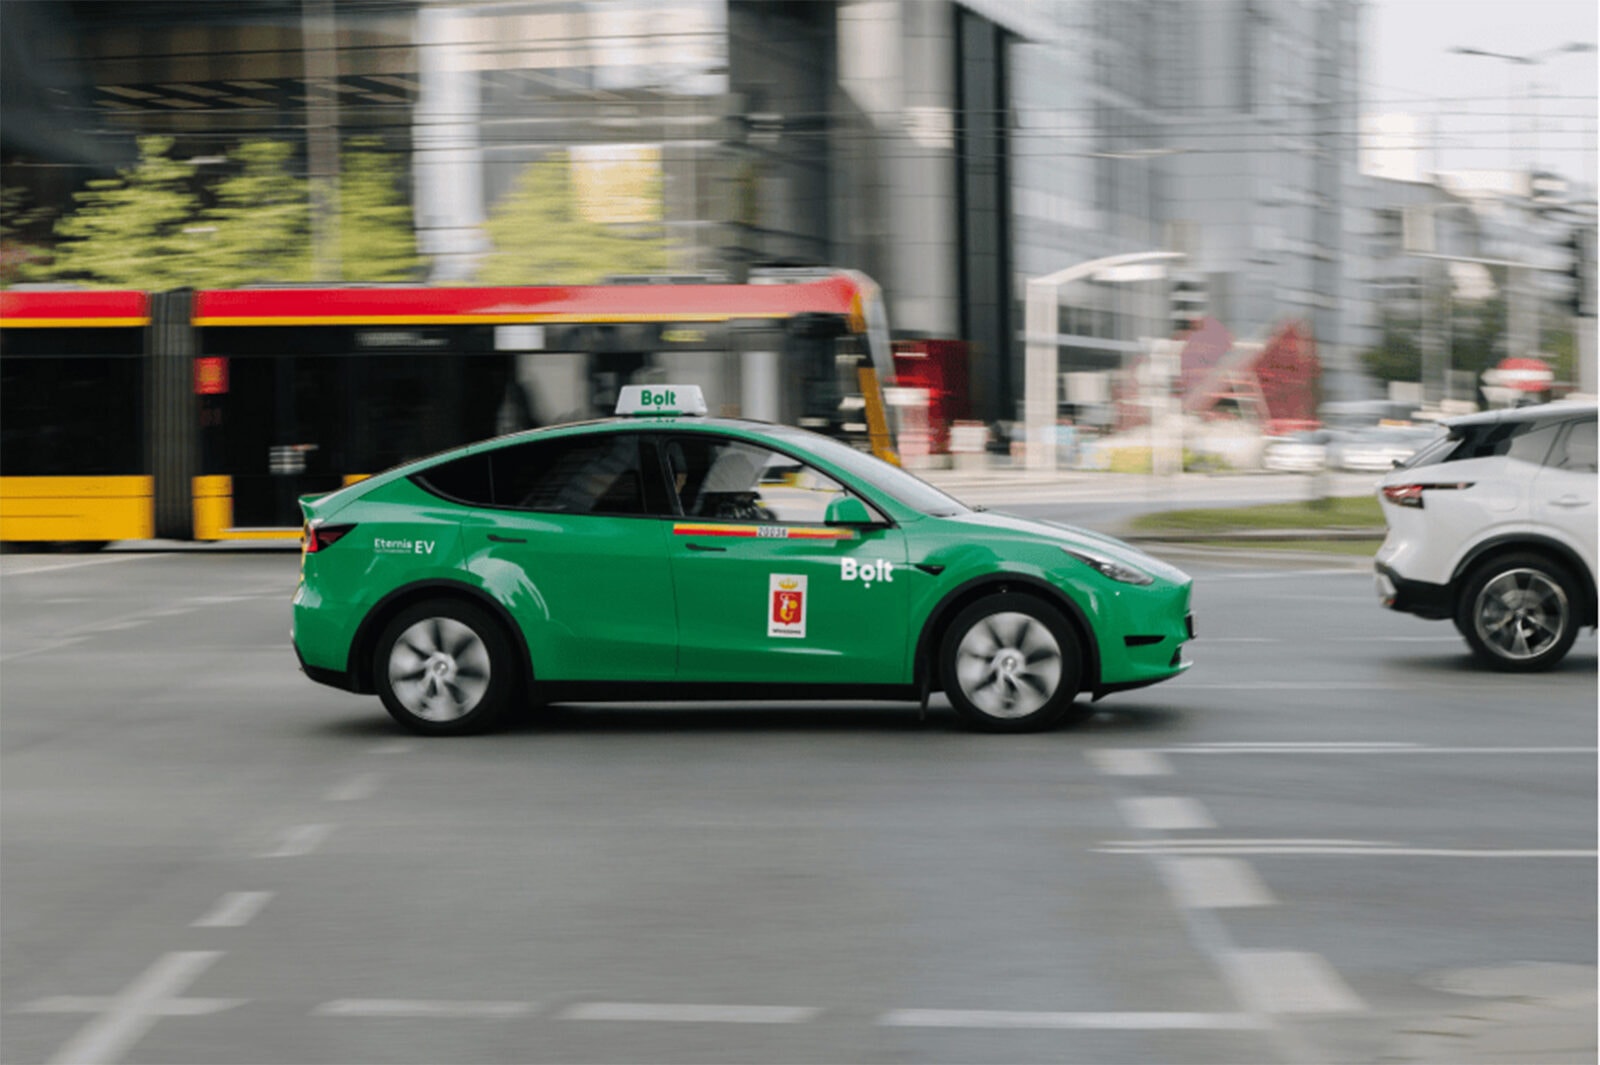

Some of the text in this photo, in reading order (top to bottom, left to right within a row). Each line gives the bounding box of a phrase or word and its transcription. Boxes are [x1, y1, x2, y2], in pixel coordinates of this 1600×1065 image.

[641, 390, 676, 409] Bolt
[415, 541, 435, 554] EV
[841, 557, 893, 588] Bolt
